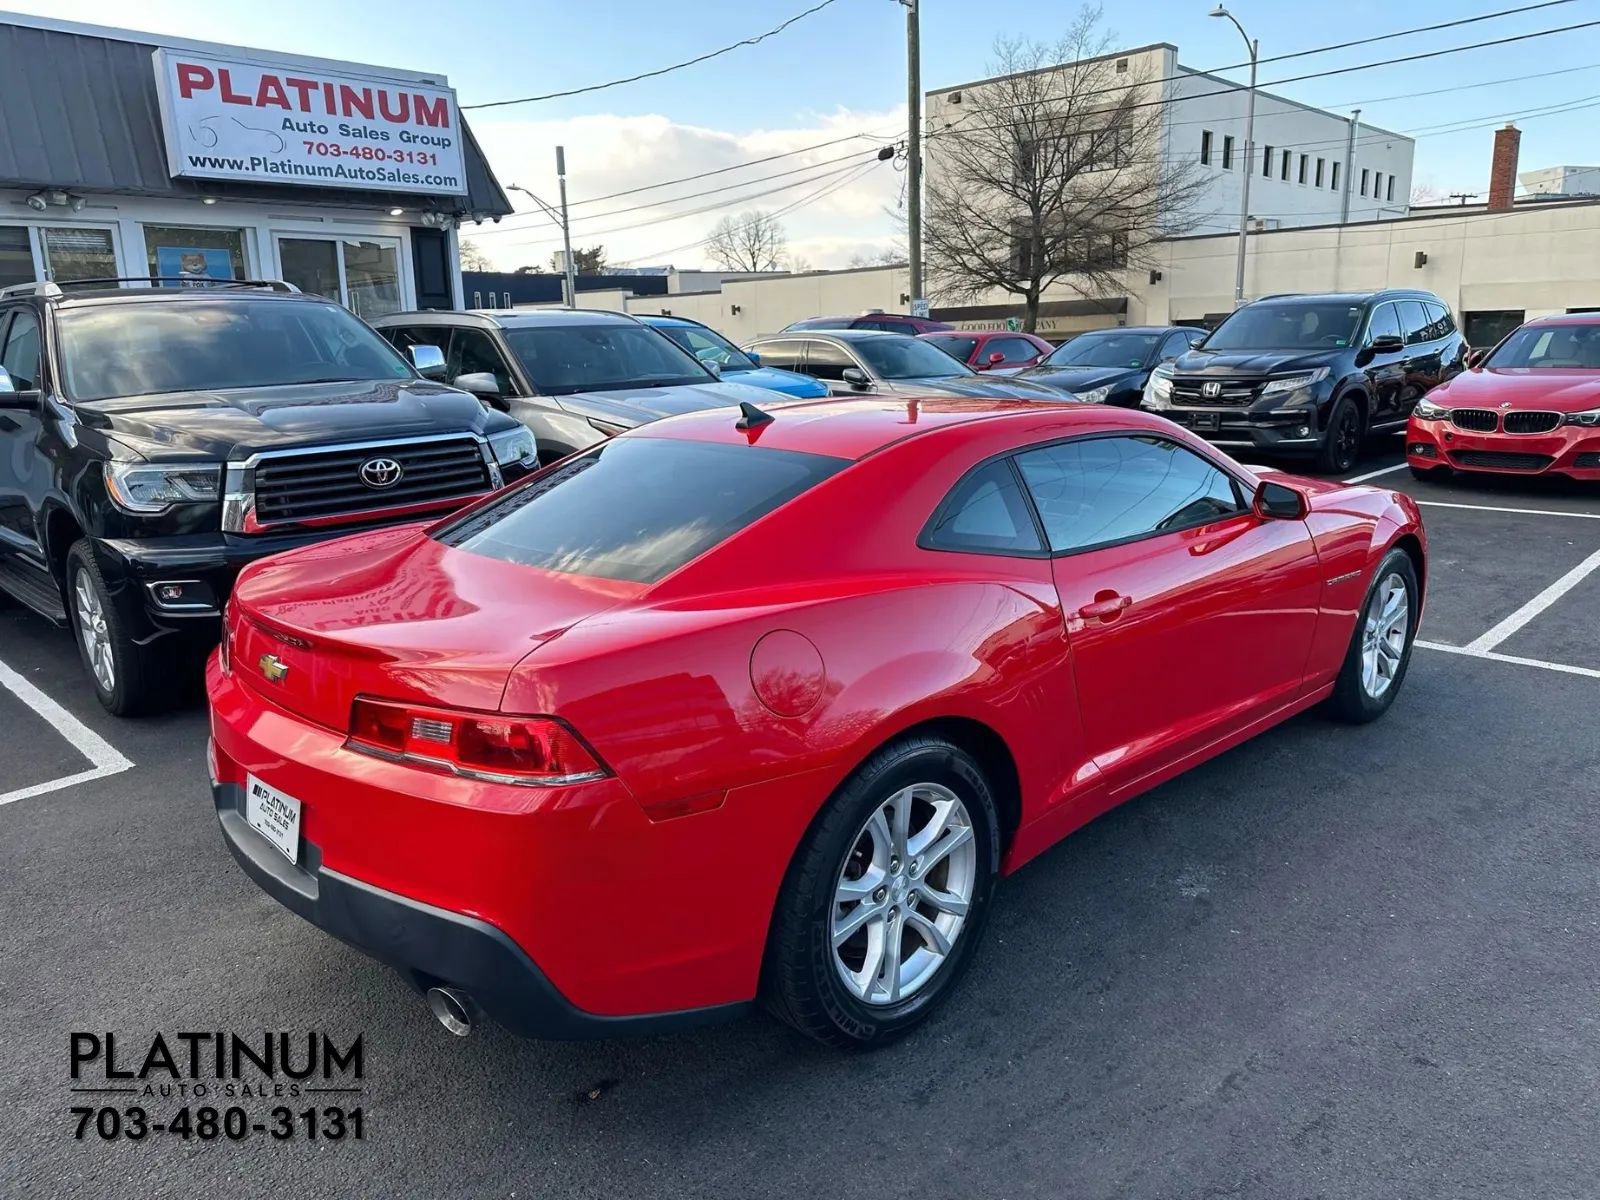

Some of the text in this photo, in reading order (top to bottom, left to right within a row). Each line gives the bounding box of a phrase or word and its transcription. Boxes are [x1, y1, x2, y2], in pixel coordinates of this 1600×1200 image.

[176, 62, 450, 129] PLATINUM
[281, 117, 452, 149] Auto Sales Group
[302, 140, 437, 167] 703-480-3131
[188, 153, 458, 187] www.PlatinumAutoSales.com
[961, 323, 986, 331] GOOD
[260, 803, 273, 818] AUTO
[274, 812, 289, 830] SALES
[261, 790, 296, 824] PLATINUM
